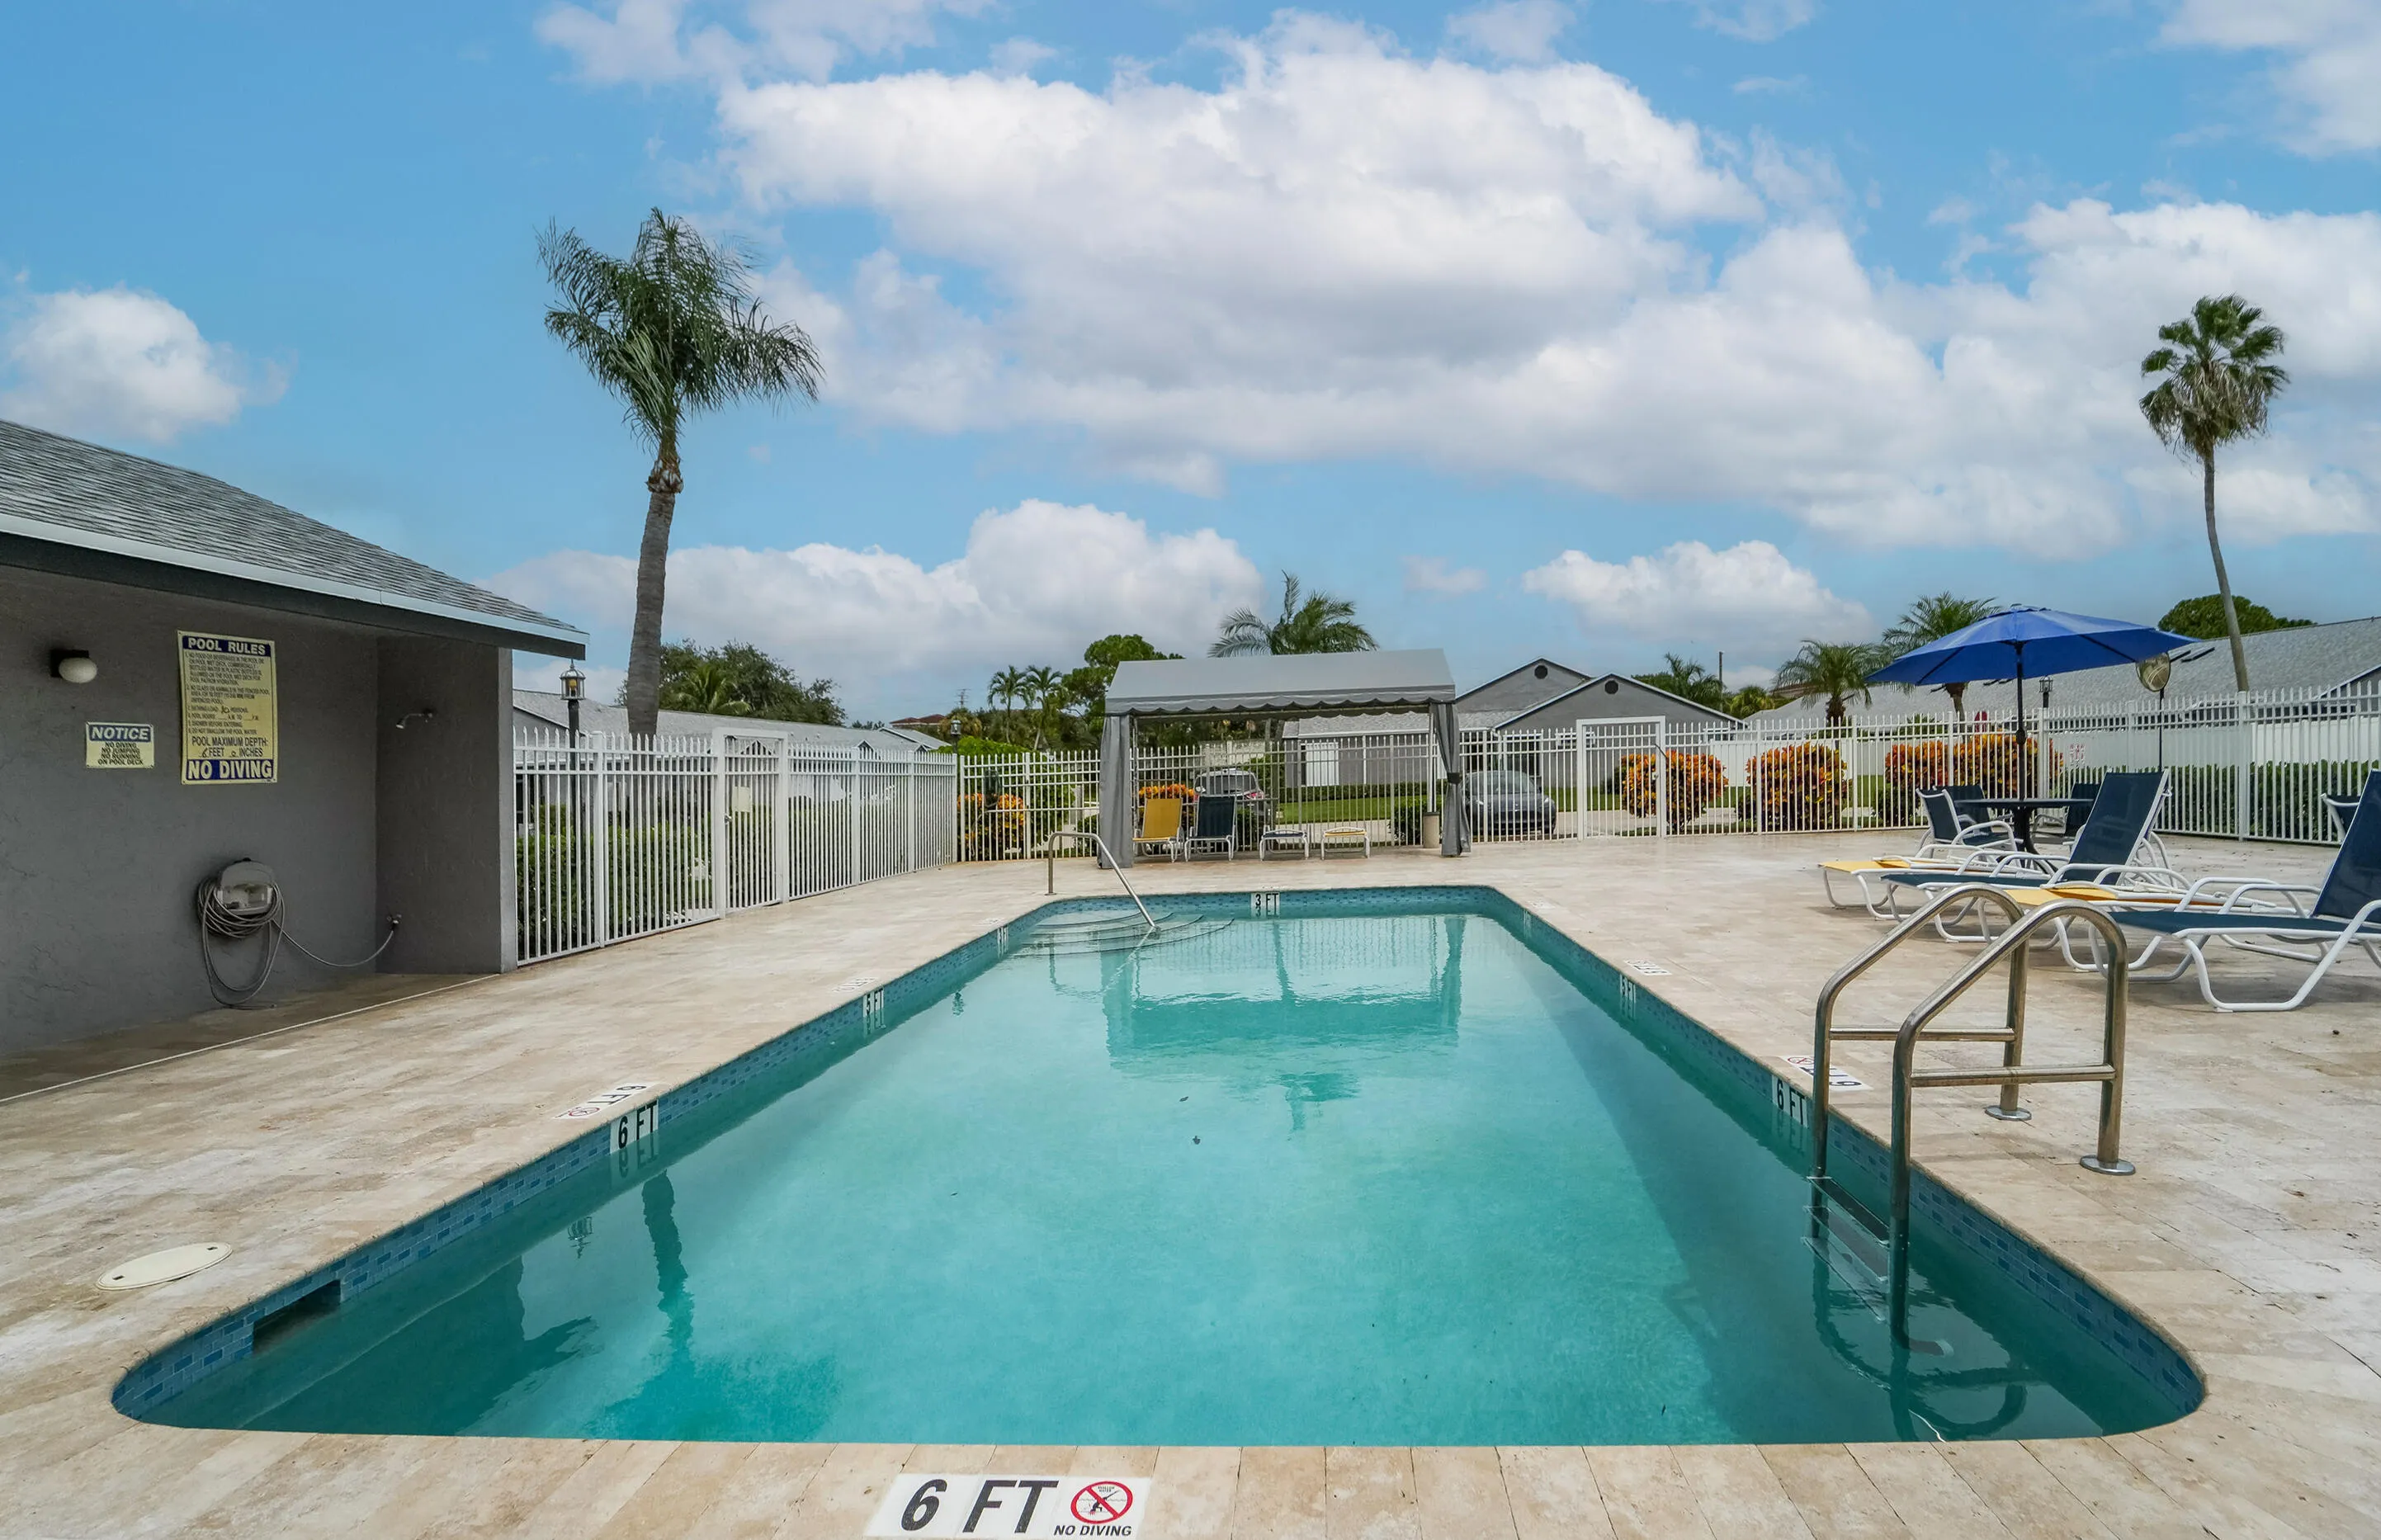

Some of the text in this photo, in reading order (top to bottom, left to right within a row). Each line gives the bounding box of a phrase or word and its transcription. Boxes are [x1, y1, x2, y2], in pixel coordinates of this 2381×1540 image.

[188, 637, 266, 654] POOL RULES
[92, 727, 149, 739] NOTICE
[191, 736, 210, 746] POOL
[211, 736, 243, 746] MAXIMUM
[208, 747, 224, 757] FEET
[239, 748, 263, 757] INCHES
[188, 759, 272, 779] NO DIVING
[1255, 893, 1278, 906] 3 FT
[1777, 1079, 1805, 1125] 6 FT
[618, 1100, 658, 1149] 6 FT
[900, 1478, 1060, 1534] 6 FT
[1054, 1525, 1132, 1538] NO DIVING
